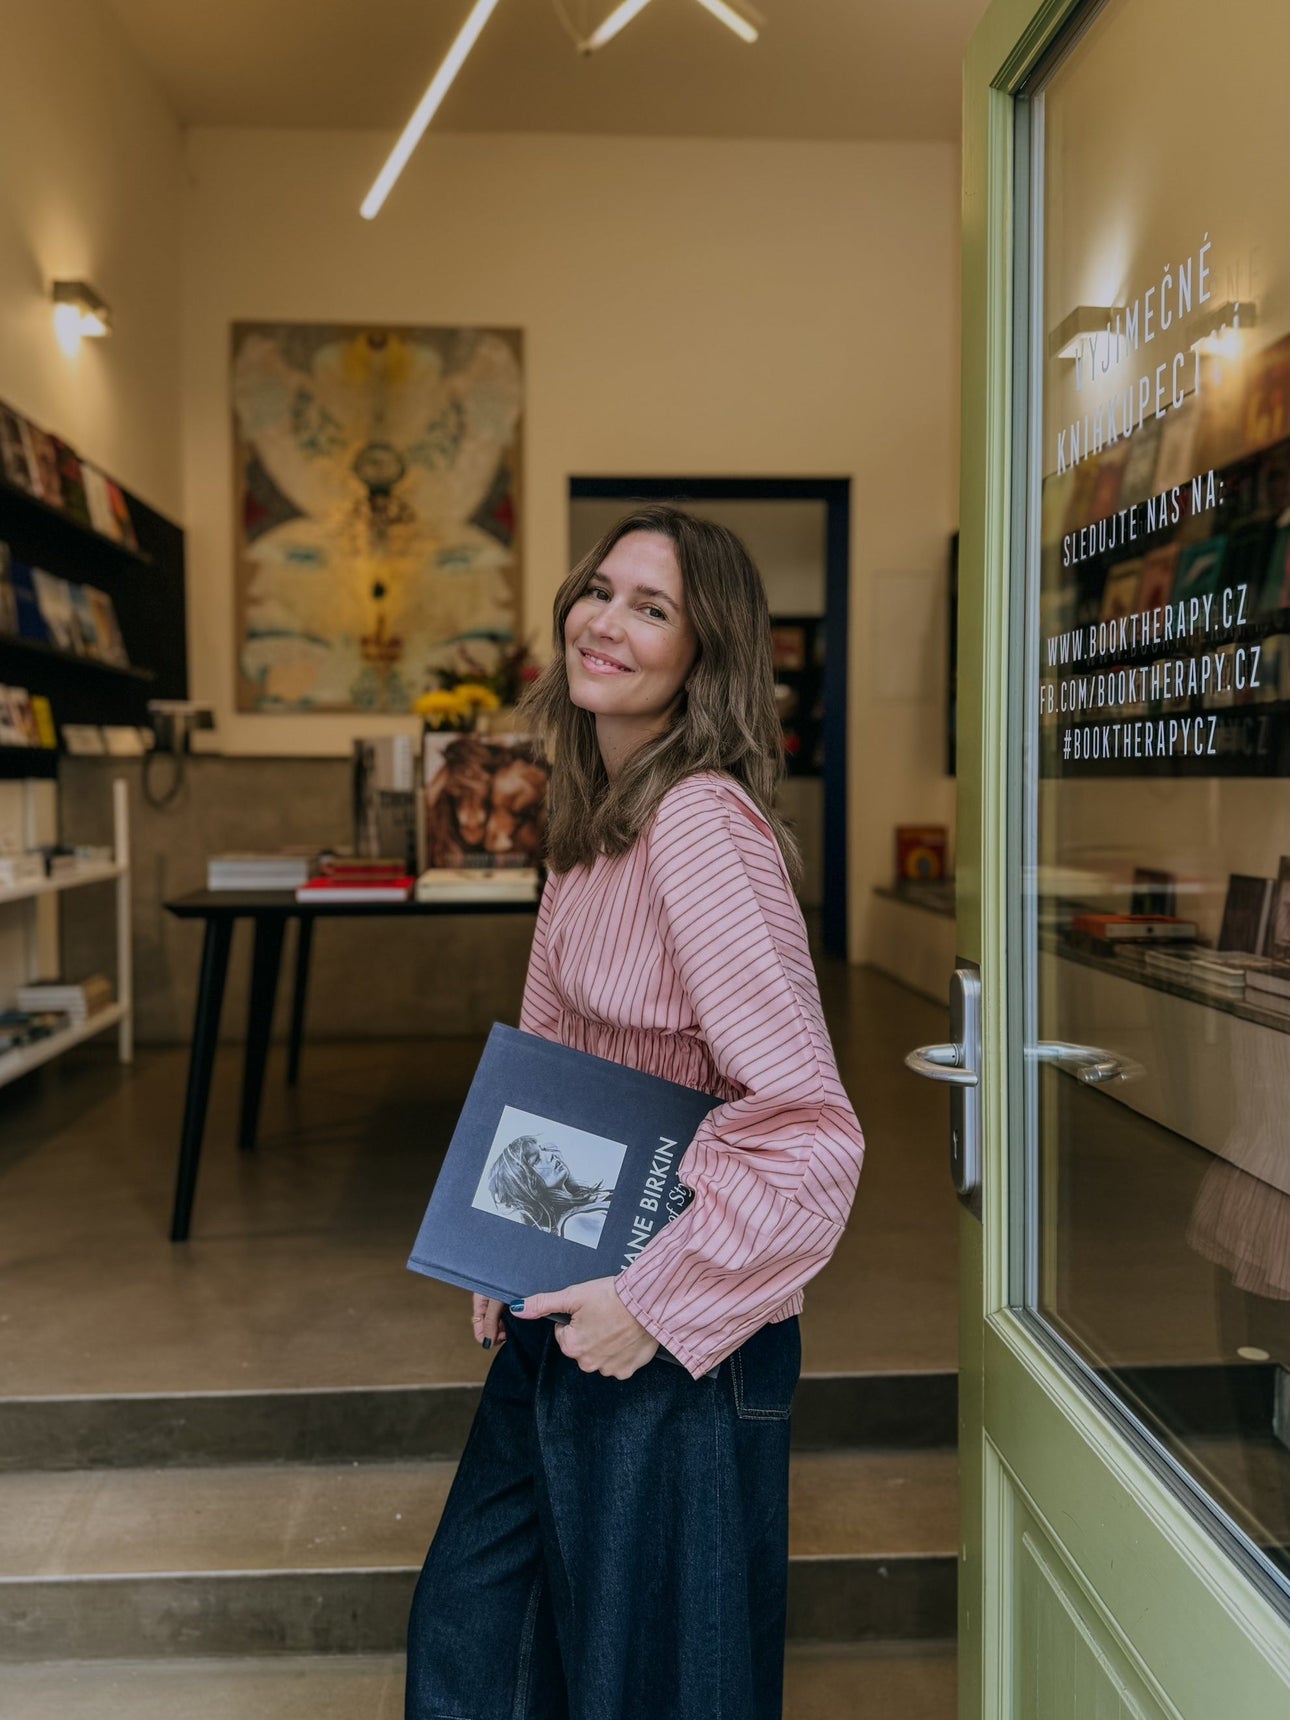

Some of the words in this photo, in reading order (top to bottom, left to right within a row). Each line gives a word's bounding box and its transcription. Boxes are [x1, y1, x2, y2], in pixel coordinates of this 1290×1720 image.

[1063, 504, 1138, 567] SLEDUJTE
[1147, 486, 1180, 534] NAS
[1191, 469, 1224, 515] NA:
[1047, 584, 1248, 667] WWW.BOOKTHERAPY.CZ
[1040, 645, 1261, 715] FB.COM/BOOKTHERAPY.CZ
[1063, 715, 1217, 760] #BOOKTHERAPYCZ
[620, 1215, 654, 1271] ANE
[639, 1136, 678, 1213] BIRKIN
